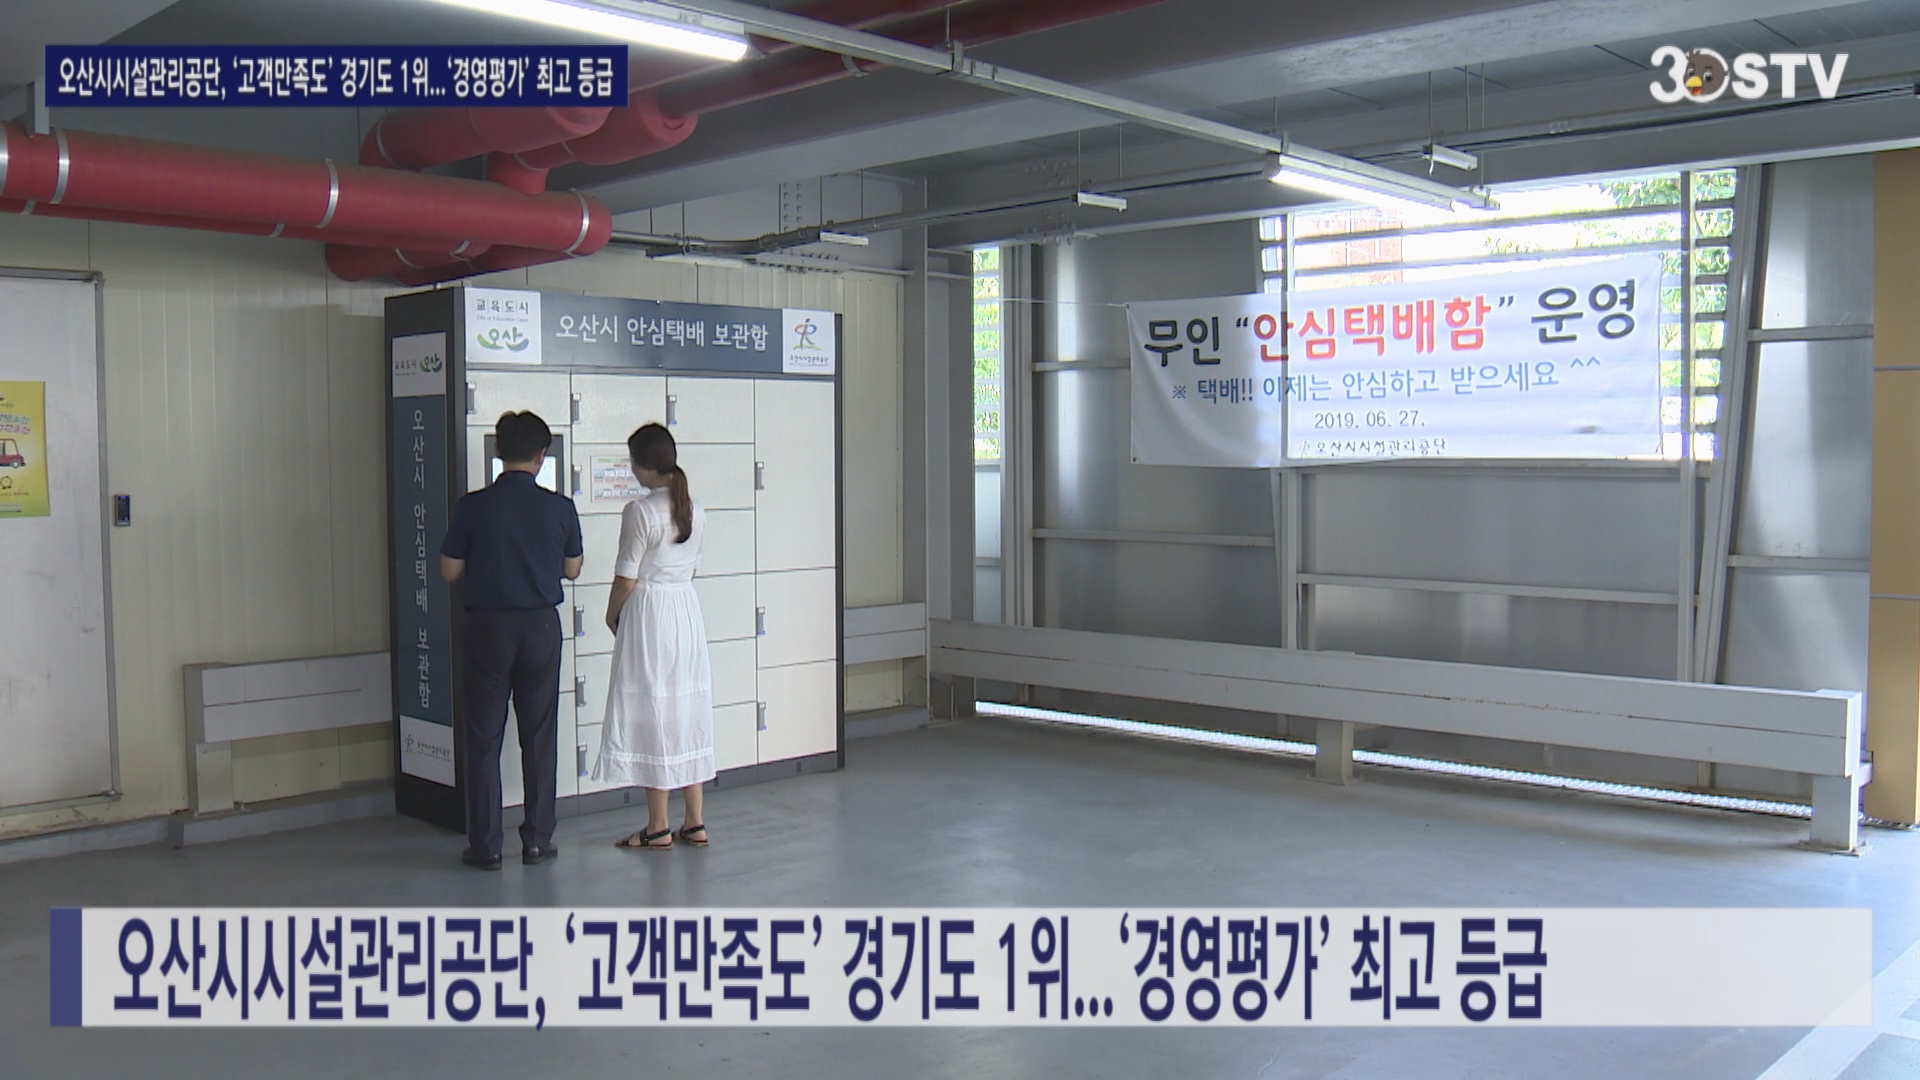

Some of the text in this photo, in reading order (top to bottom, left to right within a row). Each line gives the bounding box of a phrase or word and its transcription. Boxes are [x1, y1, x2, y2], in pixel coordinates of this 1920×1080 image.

[476, 299, 529, 314] 교육도시
[1144, 316, 1221, 367] 무인
[1530, 278, 1636, 343] 운영
[476, 326, 530, 353] 오산
[555, 314, 769, 352] 오산시 안심택배 보관함
[1197, 377, 1253, 404] 택배!!
[1263, 375, 1332, 402] 이제는
[1342, 368, 1439, 400] 안심하고
[1451, 360, 1559, 395] 받으세요
[1314, 410, 1425, 429] 2019. 06. 27.
[412, 409, 431, 709] 오산시 안심택배 보관함
